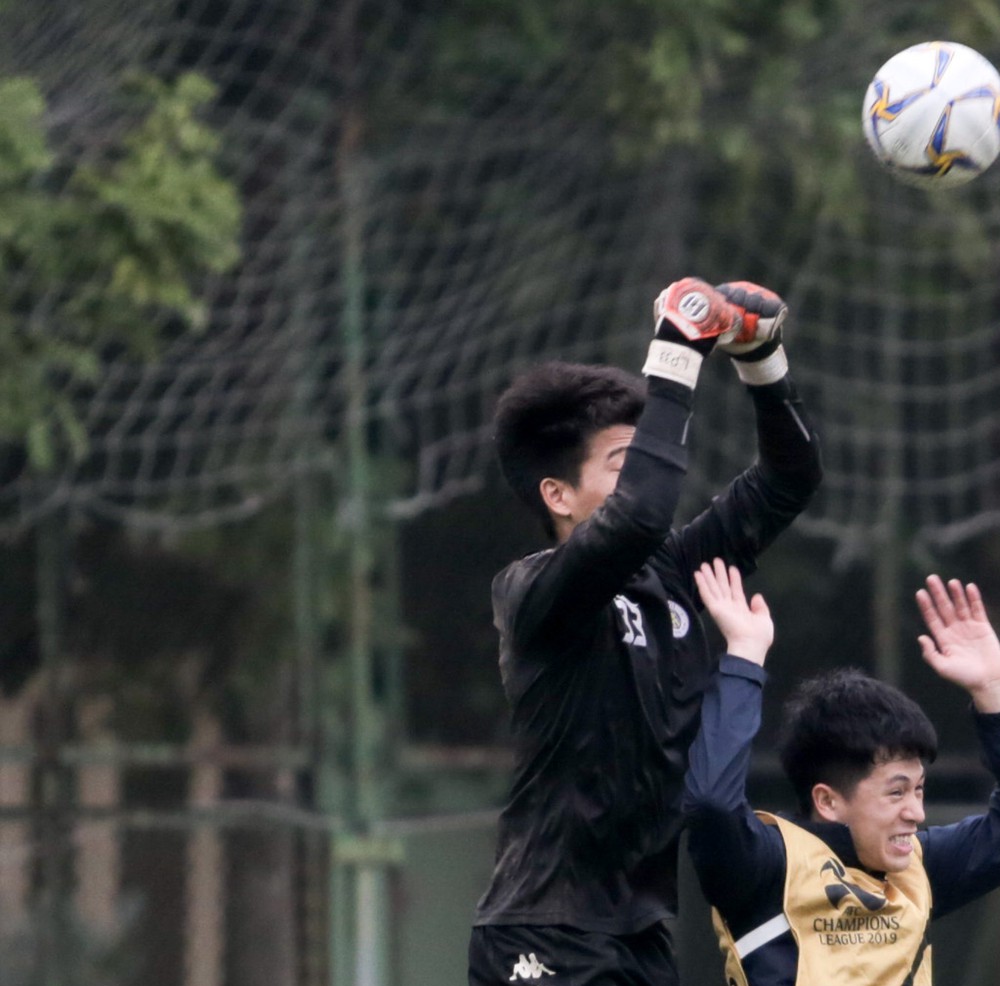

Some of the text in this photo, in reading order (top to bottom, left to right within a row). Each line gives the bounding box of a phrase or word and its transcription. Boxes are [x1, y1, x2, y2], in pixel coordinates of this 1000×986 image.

[813, 914, 900, 932] CHAMPIONS
[819, 932, 897, 945] LEAGUE 2019
